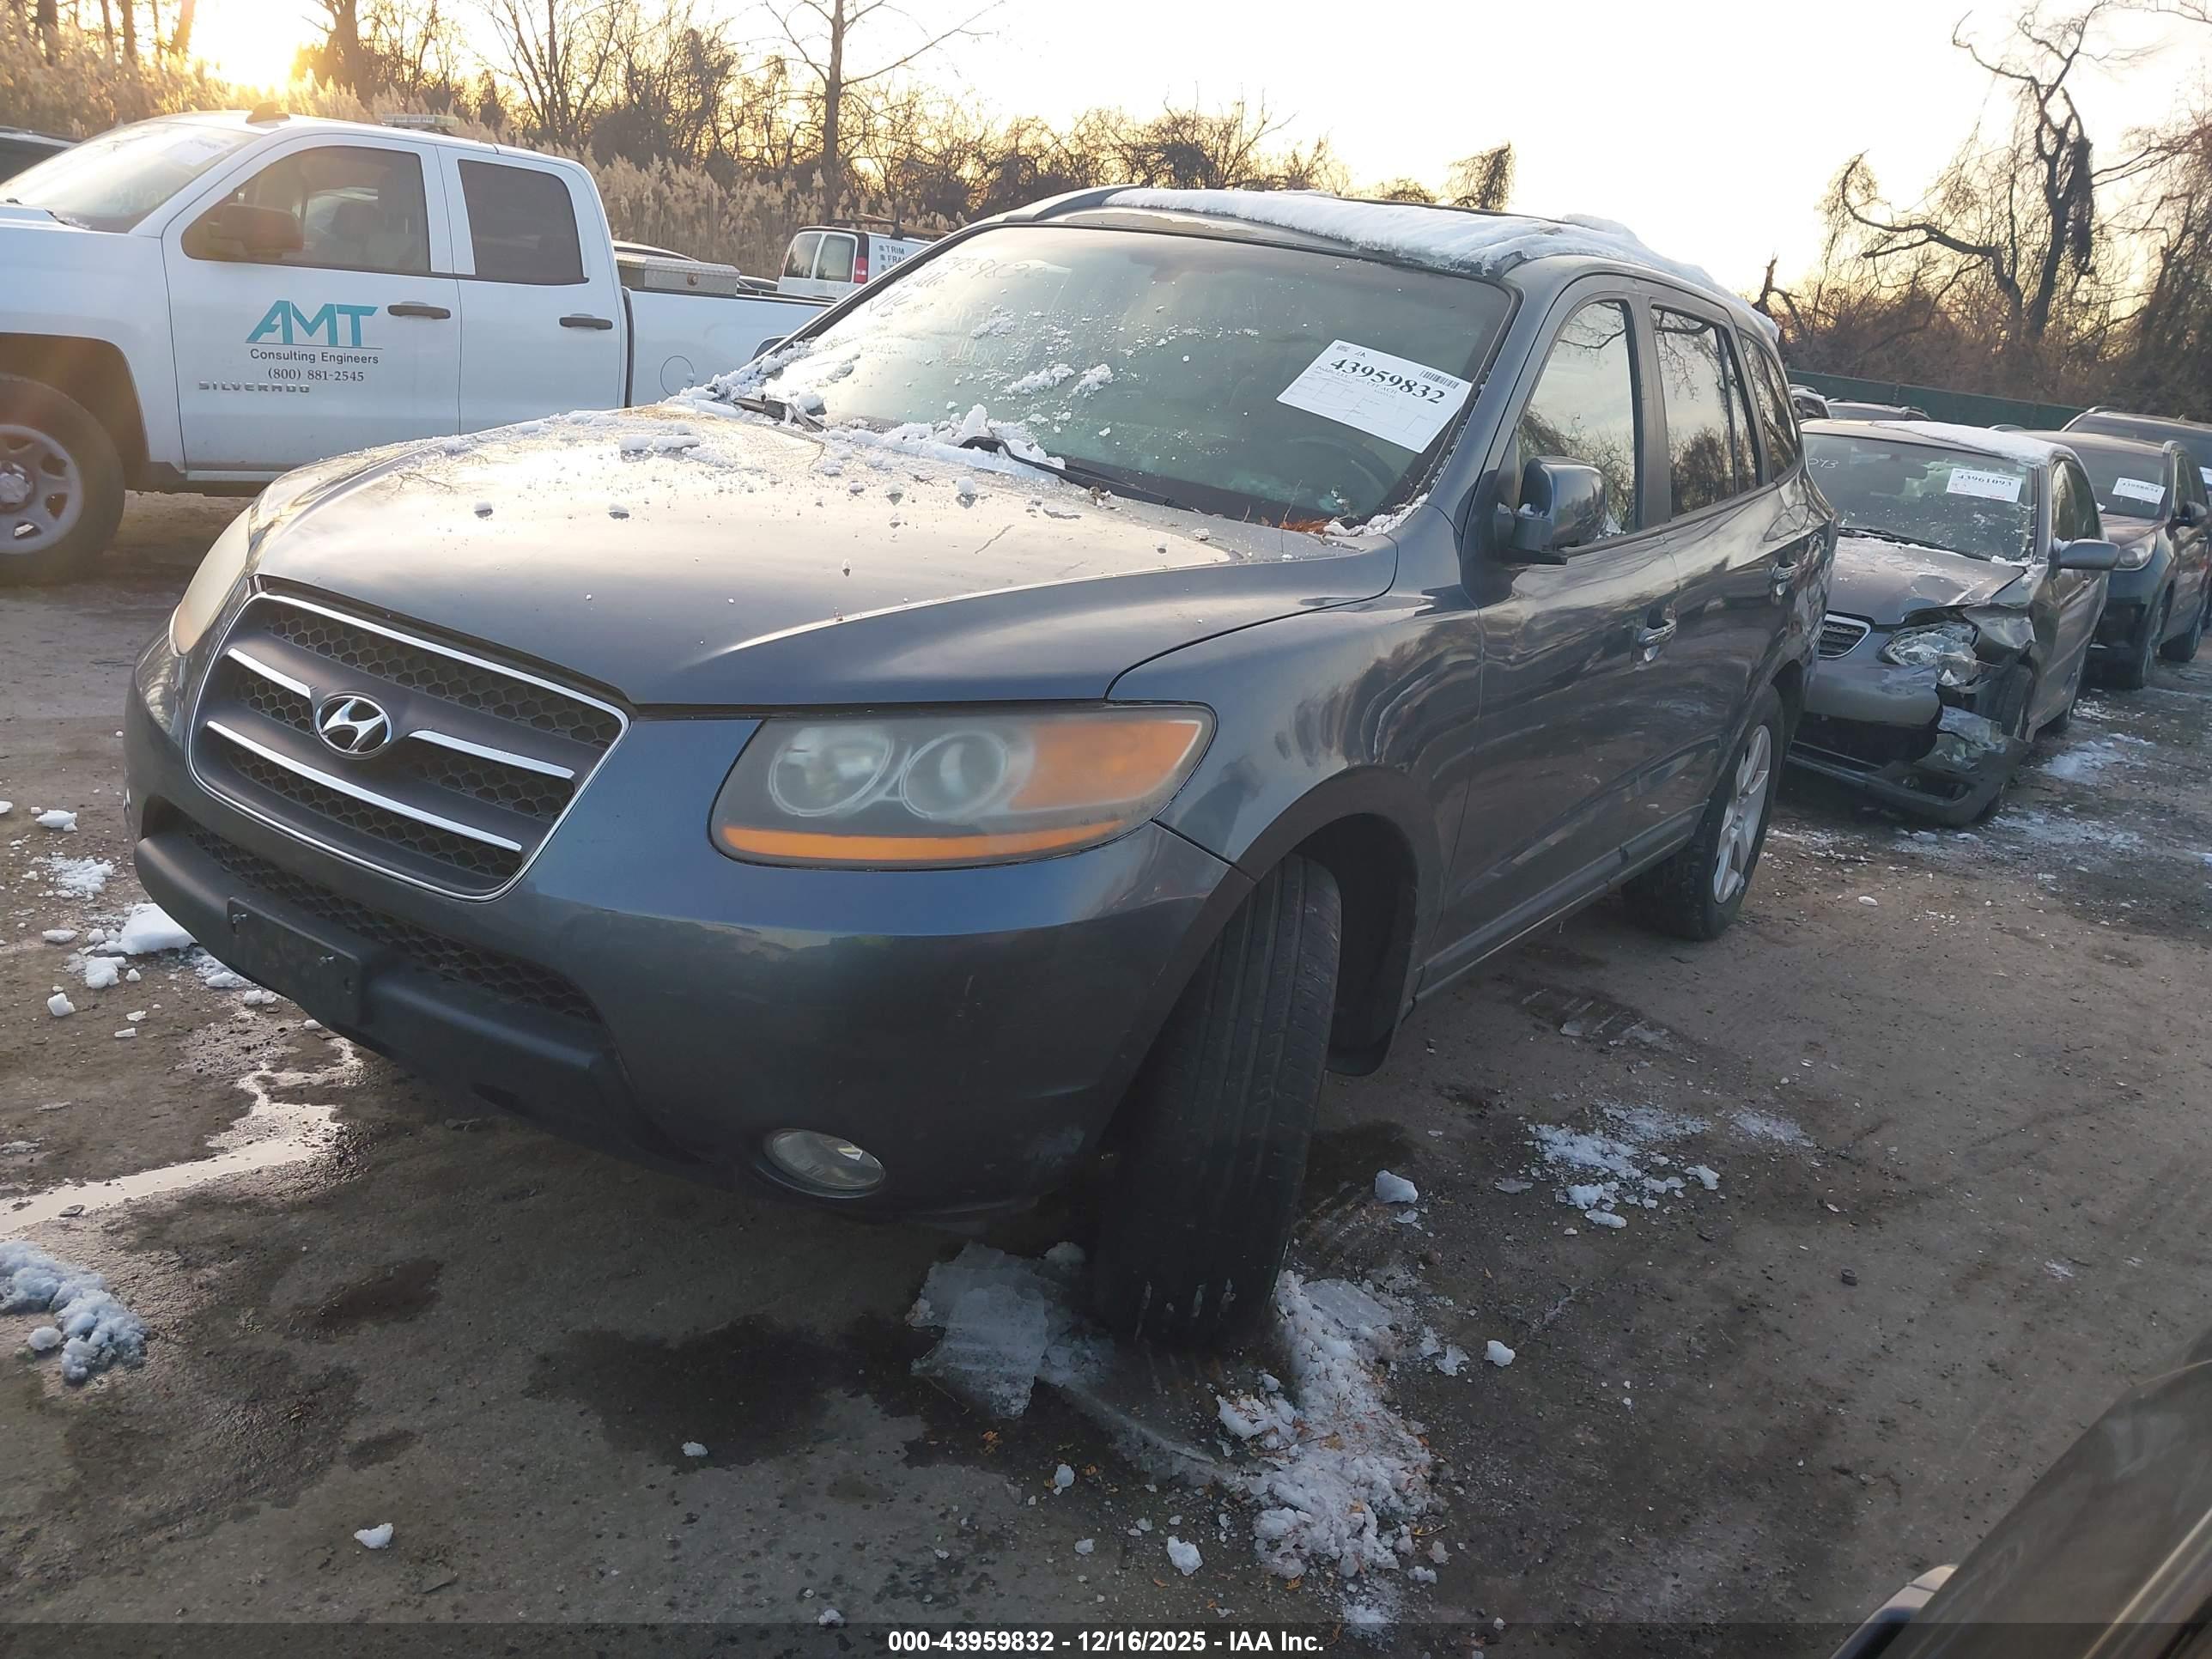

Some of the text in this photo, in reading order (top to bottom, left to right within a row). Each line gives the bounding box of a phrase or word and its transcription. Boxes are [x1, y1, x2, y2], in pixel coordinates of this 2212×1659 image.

[885, 245, 905, 255] TRIM
[246, 300, 379, 348] AMT
[250, 349, 379, 365] Consulting Engineers
[268, 367, 364, 382] (800) 881-2545
[1330, 358, 1445, 404] 43959832
[198, 381, 310, 393] SILVERADO
